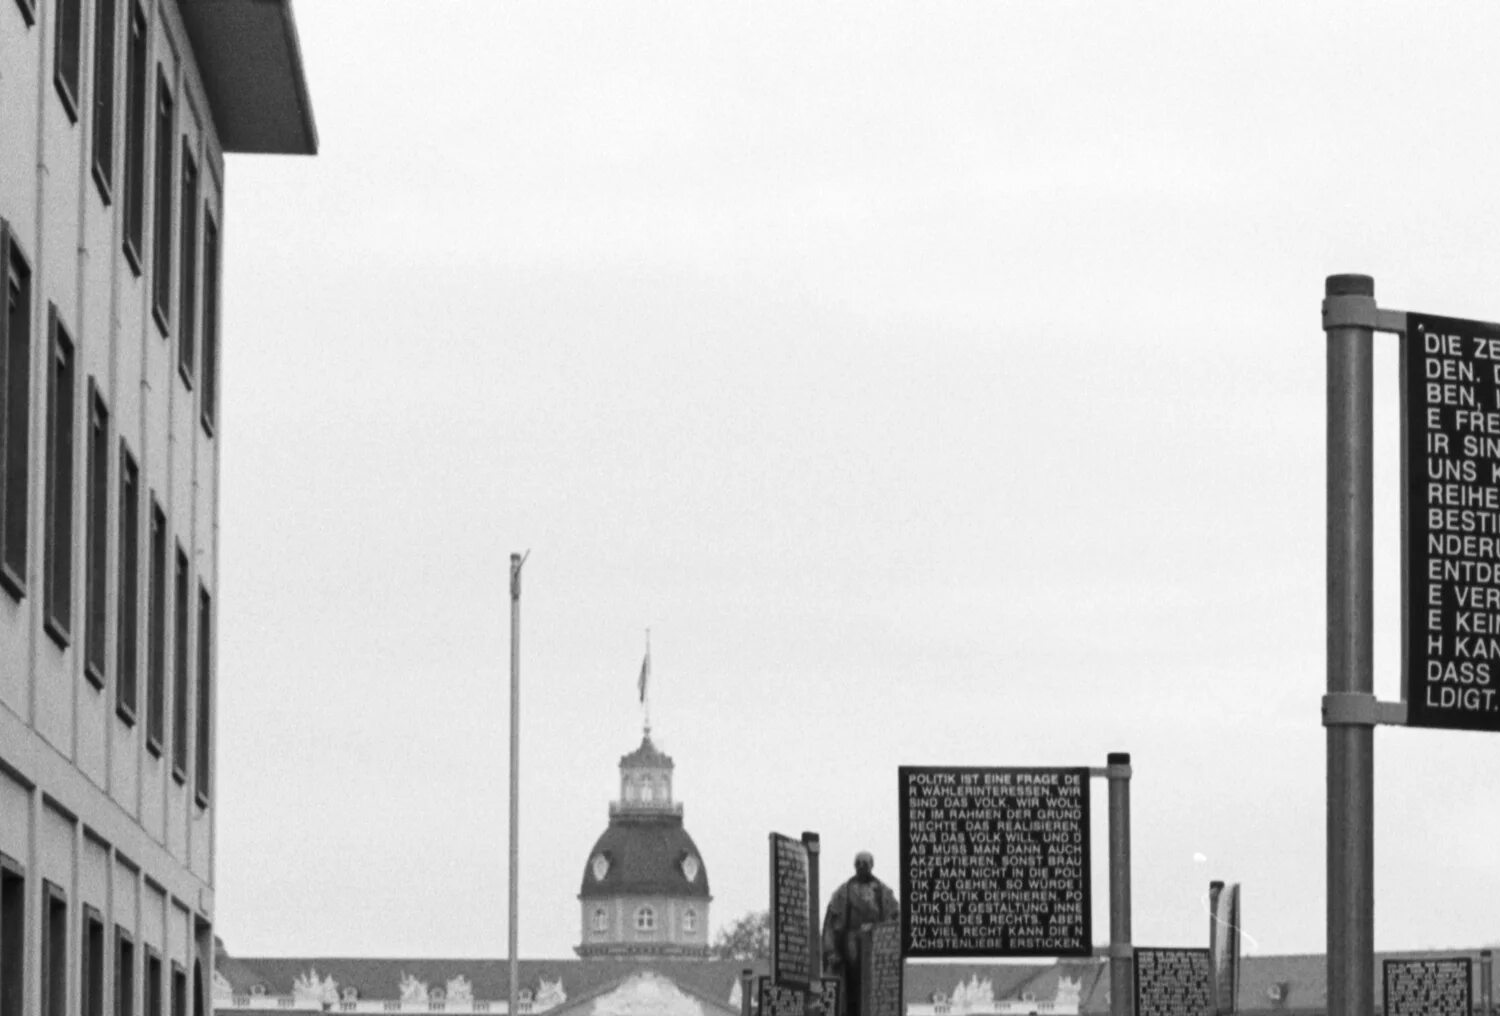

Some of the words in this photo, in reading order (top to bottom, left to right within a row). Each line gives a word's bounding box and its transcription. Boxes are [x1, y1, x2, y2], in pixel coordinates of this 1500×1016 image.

[1424, 332, 1461, 355] DIE
[1425, 357, 1480, 382] DEN.
[1426, 382, 1480, 411] BEN,
[1426, 408, 1440, 428] E
[1427, 432, 1449, 454] IR
[1427, 457, 1477, 481] UNS
[1428, 584, 1442, 604] E
[1428, 609, 1441, 629] E
[1427, 635, 1442, 655] H
[1427, 660, 1490, 684] DASS
[1426, 686, 1498, 710] LDIGT.
[908, 774, 956, 784] POLITIK
[960, 773, 980, 784] IST
[983, 774, 1012, 784] EINE
[1016, 774, 1059, 784] FRAGE
[909, 798, 938, 808] SIND
[1045, 798, 1081, 808] WOLL
[949, 809, 1002, 819] RAHMEN
[1037, 809, 1082, 820] GRUND
[909, 821, 958, 831] RECHTE
[969, 833, 1001, 843] VOLK
[932, 844, 967, 854] MUSS
[1006, 844, 1041, 854] DANN
[1047, 844, 1082, 855] AUCH
[1001, 856, 1043, 866] SONST
[1047, 856, 1082, 866] BRAU
[971, 868, 1007, 878] NICHT
[1054, 868, 1082, 878] POLI
[932, 891, 979, 901] POLITIK
[910, 903, 940, 913] LITIK
[1053, 903, 1082, 913] INNE
[910, 915, 952, 925] RHALB
[1048, 914, 1083, 924] ABER
[931, 927, 957, 937] VIEL
[963, 926, 1002, 936] RECHT
[1008, 926, 1044, 936] KANN
